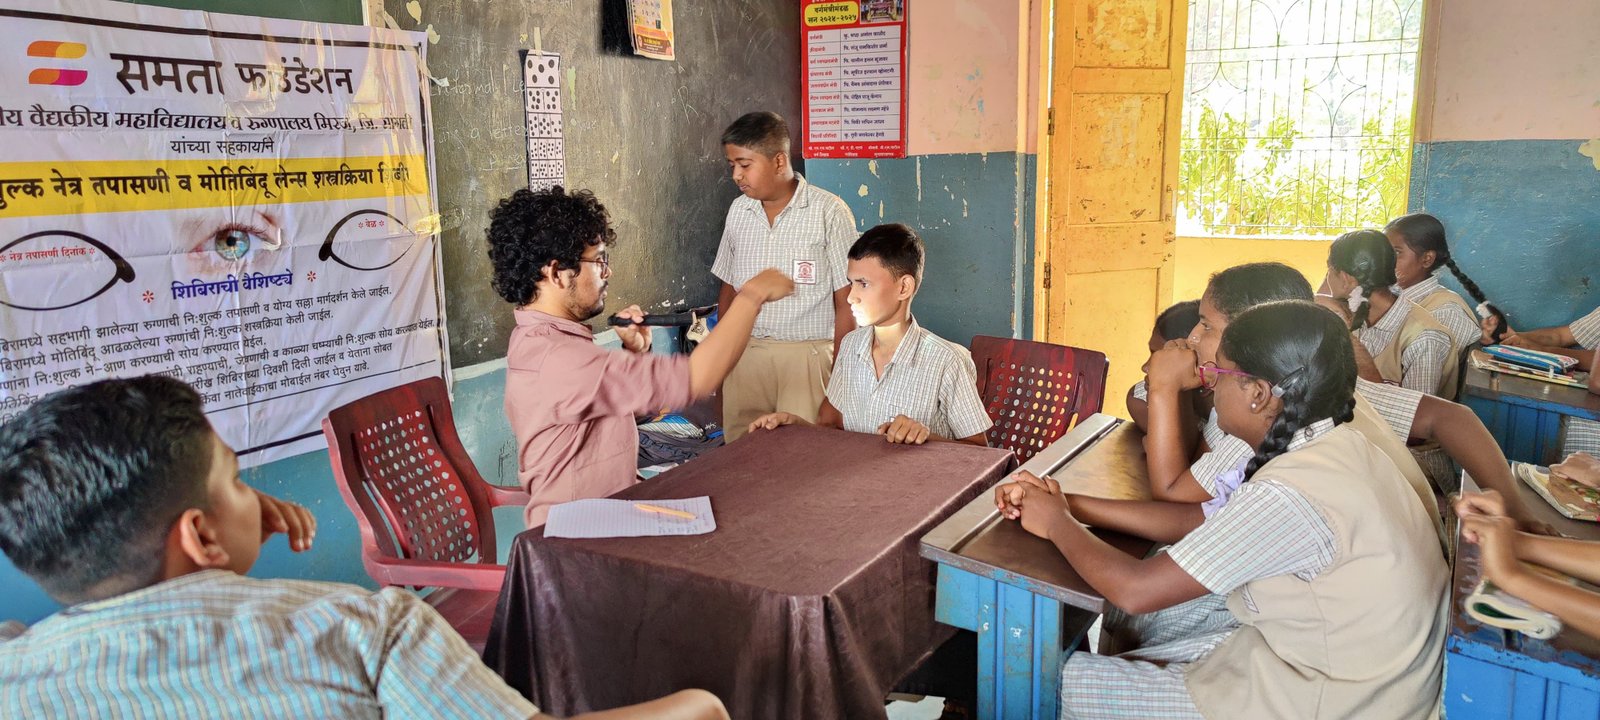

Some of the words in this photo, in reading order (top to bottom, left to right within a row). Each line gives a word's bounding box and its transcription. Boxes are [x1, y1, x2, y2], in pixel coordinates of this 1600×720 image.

[109, 53, 225, 95] समता
[28, 103, 110, 128] वैद्यकीय
[115, 108, 226, 130] महाविद्यालय
[231, 117, 242, 131] व
[245, 117, 311, 131] रुग्णालय
[170, 136, 211, 154] यांच्या
[0, 177, 44, 210] ुल्क
[50, 168, 83, 197] नेत्र
[89, 167, 170, 196] तपासणी
[176, 174, 191, 192] व
[198, 163, 277, 199] मोतिबिंदू
[274, 165, 308, 190] लेन्स
[312, 163, 373, 190] शस्त्रक्रिया
[26, 247, 59, 261] तपासणी
[61, 245, 87, 259] दिनांक
[171, 275, 239, 300] शिबिराची
[243, 268, 293, 292] वैशिष्ट्ये
[48, 326, 91, 346] सहभागी
[96, 321, 139, 339] झालेल्या
[183, 308, 222, 326] नि:शुल्क
[226, 302, 261, 319] तपासणी
[273, 298, 292, 311] योग्य
[317, 291, 349, 305] मार्गदर्शन
[351, 287, 366, 300] केले
[368, 286, 392, 298] जाईल.
[50, 344, 101, 362] मोतिबिंदू
[100, 335, 160, 356] आढळलेल्या
[164, 327, 200, 345] रुग्णांची
[204, 324, 242, 340] नि:शुल्क
[244, 317, 283, 333] शस्त्रक्रिया
[285, 311, 305, 324] केली
[308, 309, 334, 322] जाईल.
[35, 366, 81, 387] नि:शुल्क
[85, 359, 126, 377] ने-आण
[130, 348, 175, 368] करण्याची
[179, 345, 199, 360] सोय
[202, 342, 240, 355] करण्यात
[243, 335, 266, 348] येईल.
[217, 369, 260, 386] शिबिराच्या
[263, 362, 289, 377] दिवशी
[292, 358, 311, 371] दिली
[313, 352, 336, 366] जाईल
[347, 347, 371, 359] येताना
[373, 342, 393, 354] सोबत
[234, 351, 269, 366] जेवणाची
[273, 350, 278, 358] व
[378, 327, 393, 339] सोय
[280, 374, 311, 388] मोबाईल
[314, 369, 330, 381] नंबर
